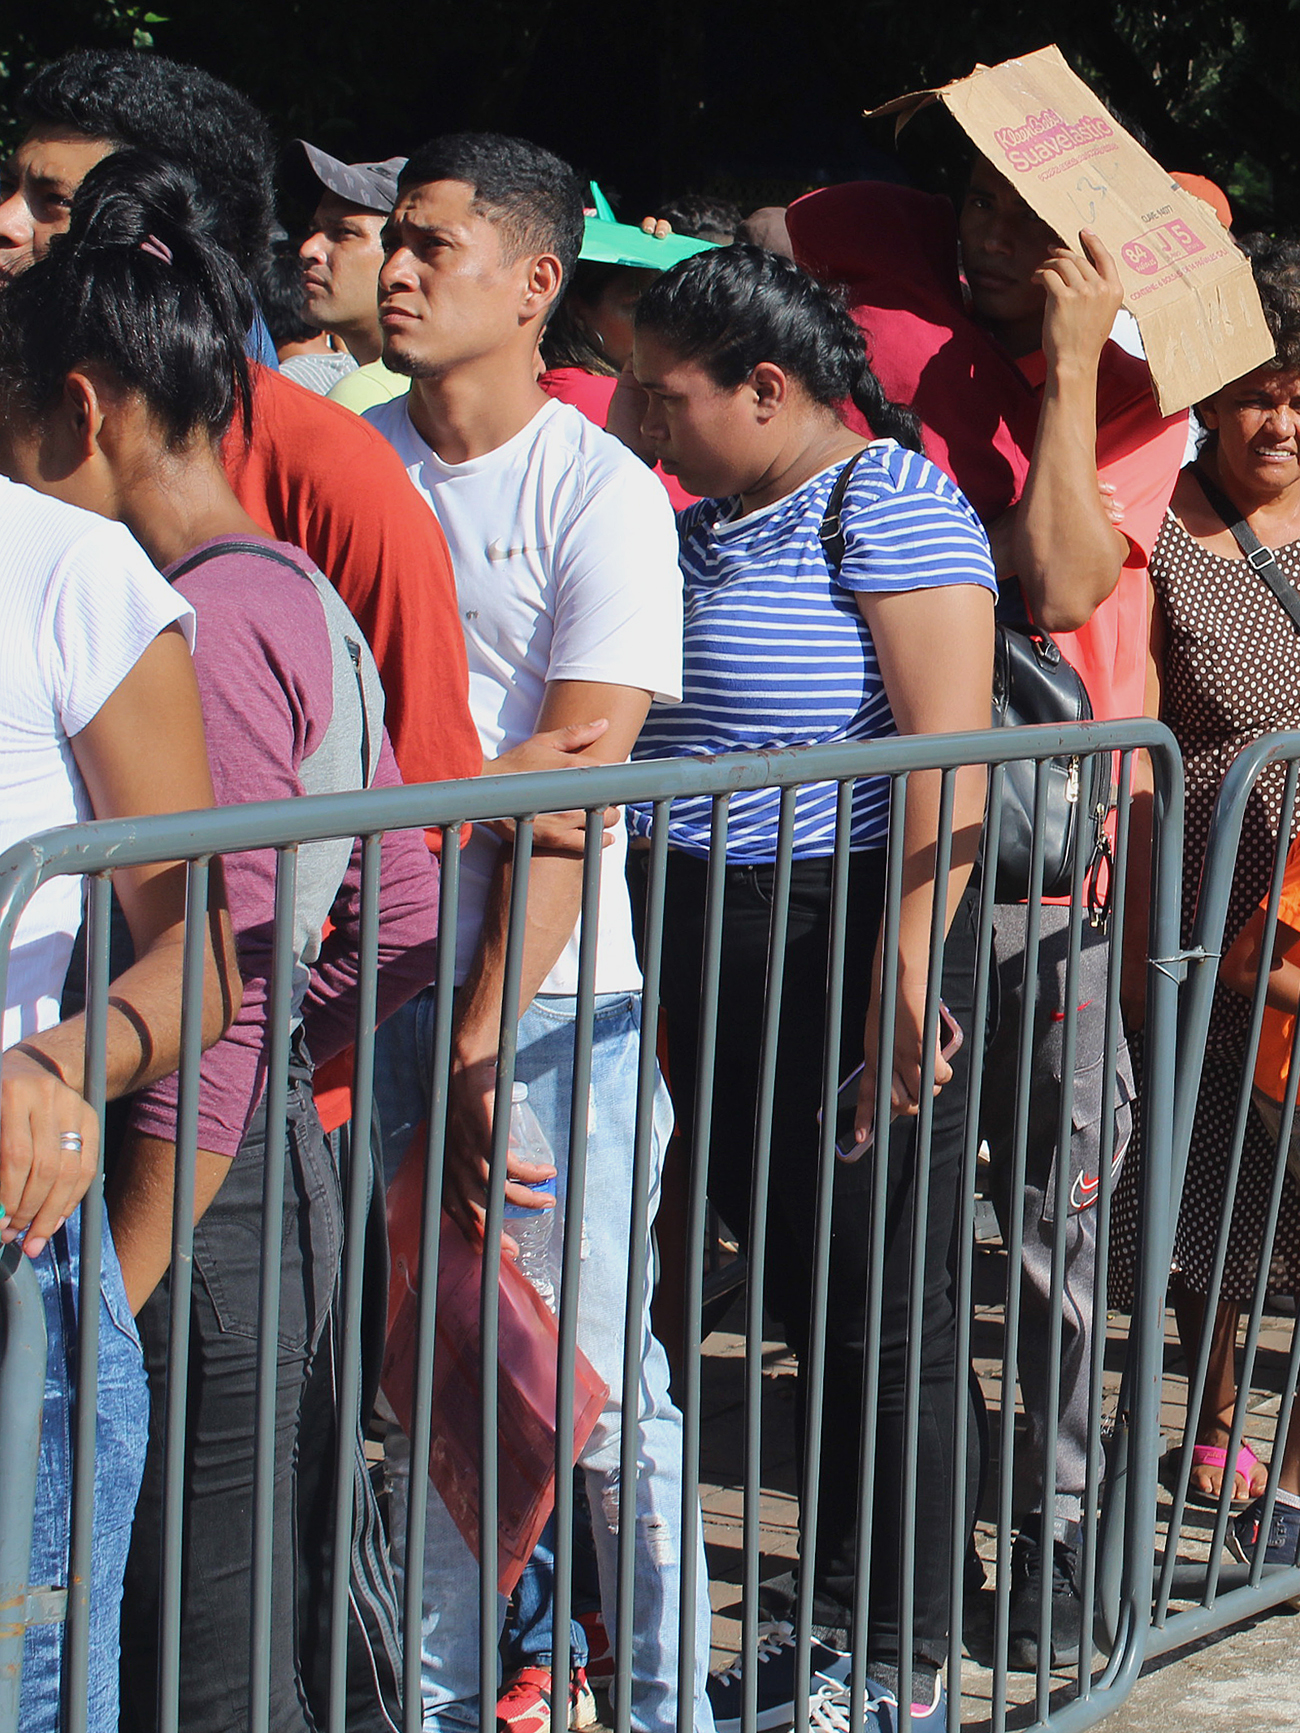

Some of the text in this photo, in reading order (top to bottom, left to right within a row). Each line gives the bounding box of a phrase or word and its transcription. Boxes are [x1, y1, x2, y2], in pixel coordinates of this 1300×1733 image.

[1008, 119, 1112, 172] Suavelastic
[1156, 231, 1172, 252] J
[1171, 224, 1193, 244] 5
[1125, 244, 1147, 263] 84
